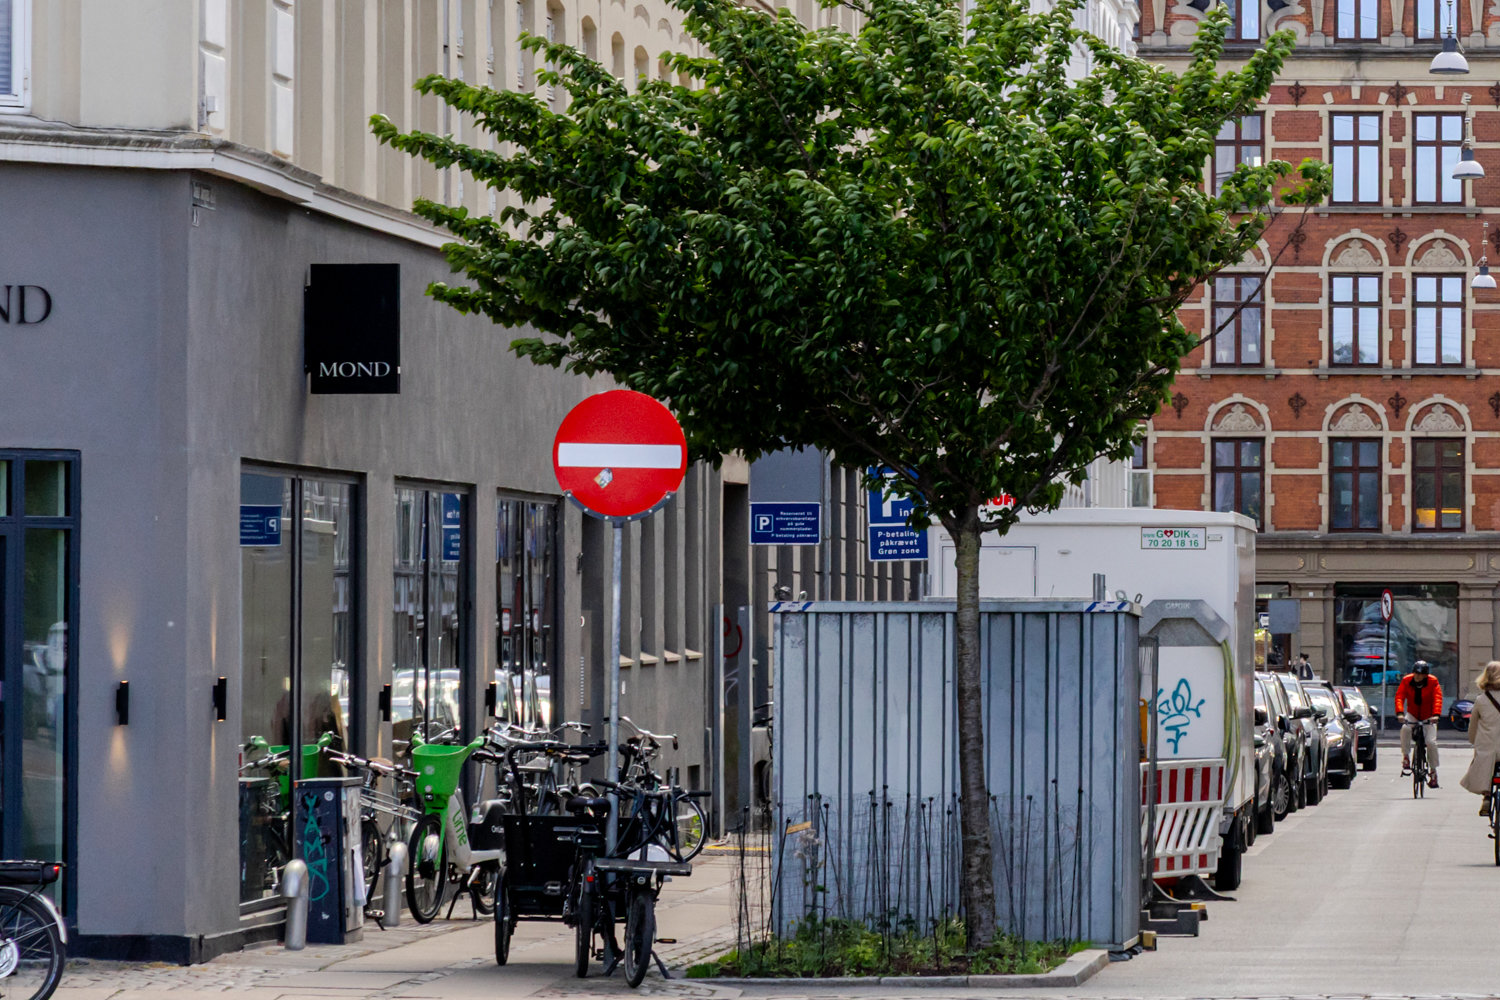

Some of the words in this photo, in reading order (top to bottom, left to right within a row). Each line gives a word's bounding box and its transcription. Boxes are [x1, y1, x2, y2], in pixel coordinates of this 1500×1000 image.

[319, 361, 391, 378] MOND
[759, 516, 770, 531] P
[879, 538, 918, 547] påkrævet
[1148, 539, 1159, 547] 70
[1161, 539, 1172, 547] 20
[1176, 539, 1186, 547] 18
[1189, 539, 1199, 547] 16
